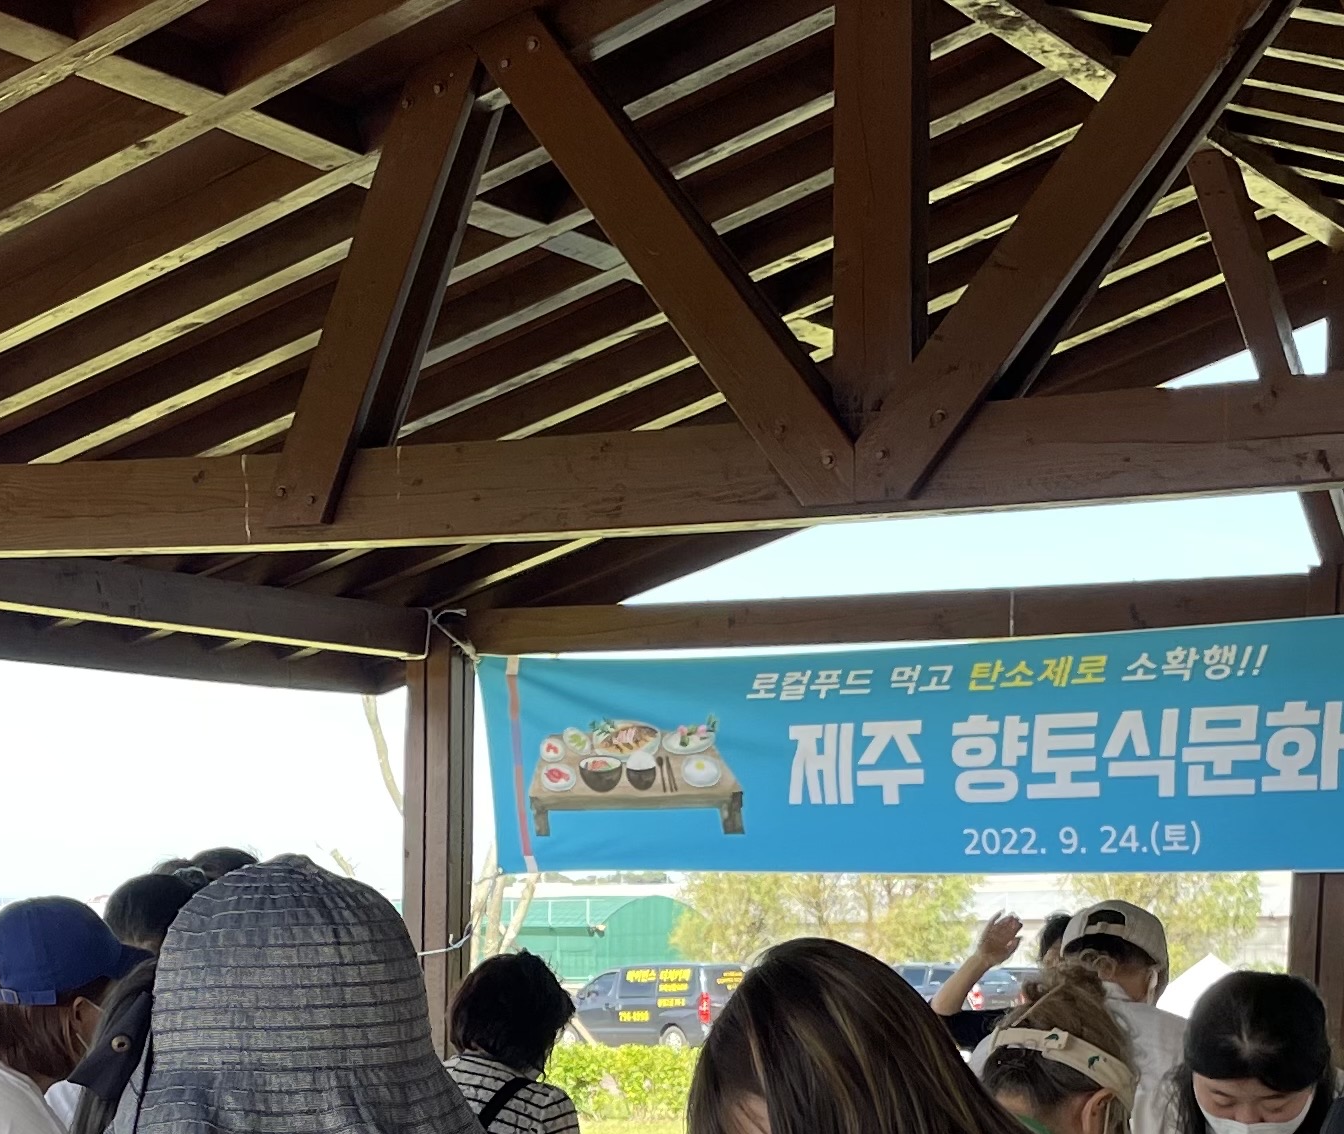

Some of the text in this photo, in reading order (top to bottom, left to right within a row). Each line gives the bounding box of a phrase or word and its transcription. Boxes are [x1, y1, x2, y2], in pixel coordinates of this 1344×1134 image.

[746, 644, 1269, 701] 로컬푸드 먹고 탄소제로 소확행!!
[788, 719, 925, 806] 제주
[962, 820, 1202, 857] 2022. 9. 24.(토)
